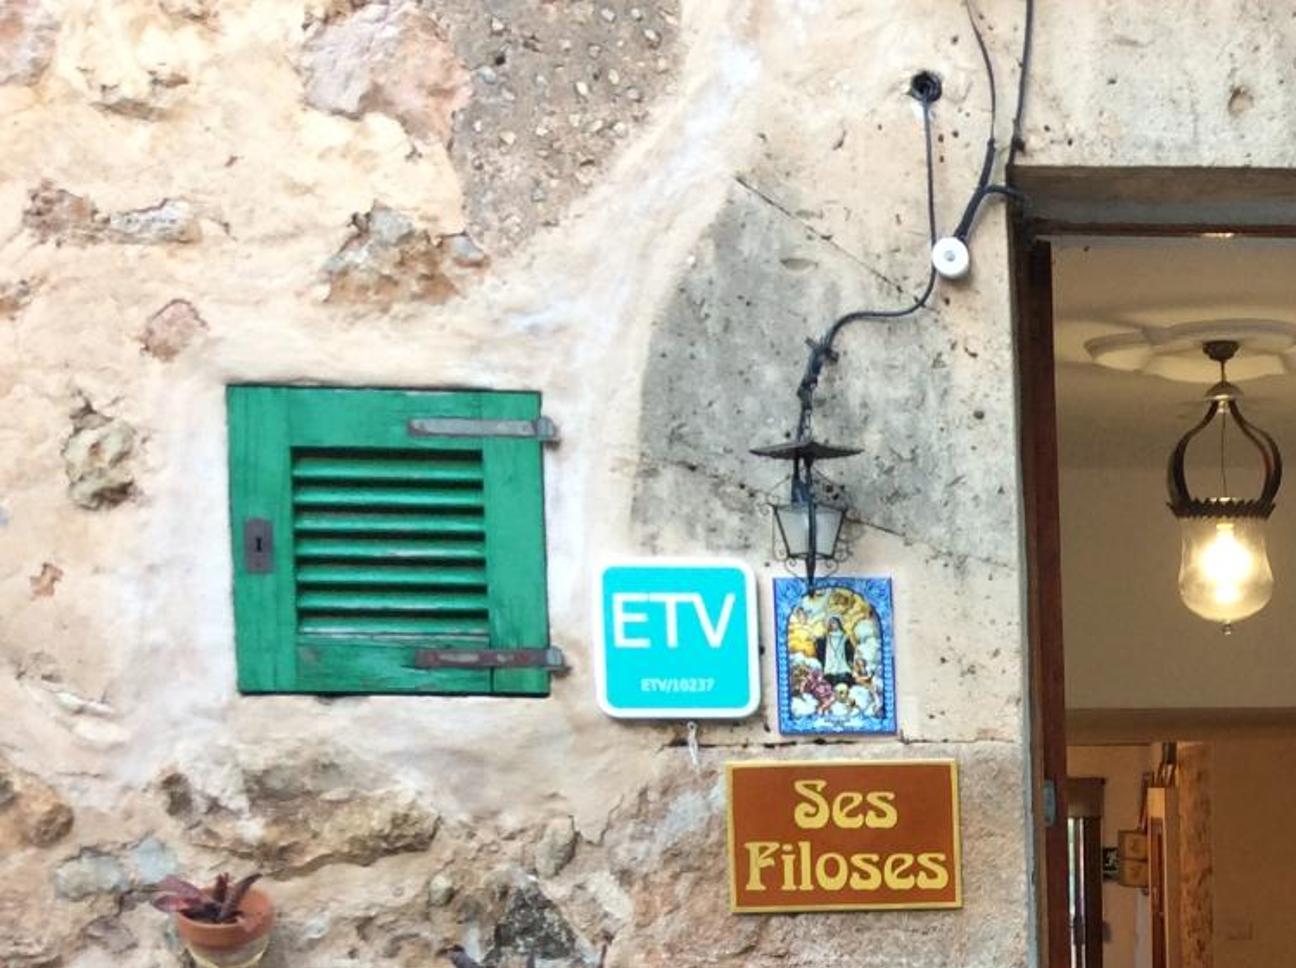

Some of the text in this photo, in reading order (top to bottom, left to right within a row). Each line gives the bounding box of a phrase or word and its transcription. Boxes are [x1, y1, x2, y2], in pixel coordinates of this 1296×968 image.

[612, 592, 736, 648] ETV
[794, 779, 898, 829] Ses
[744, 841, 949, 891] Filoses
